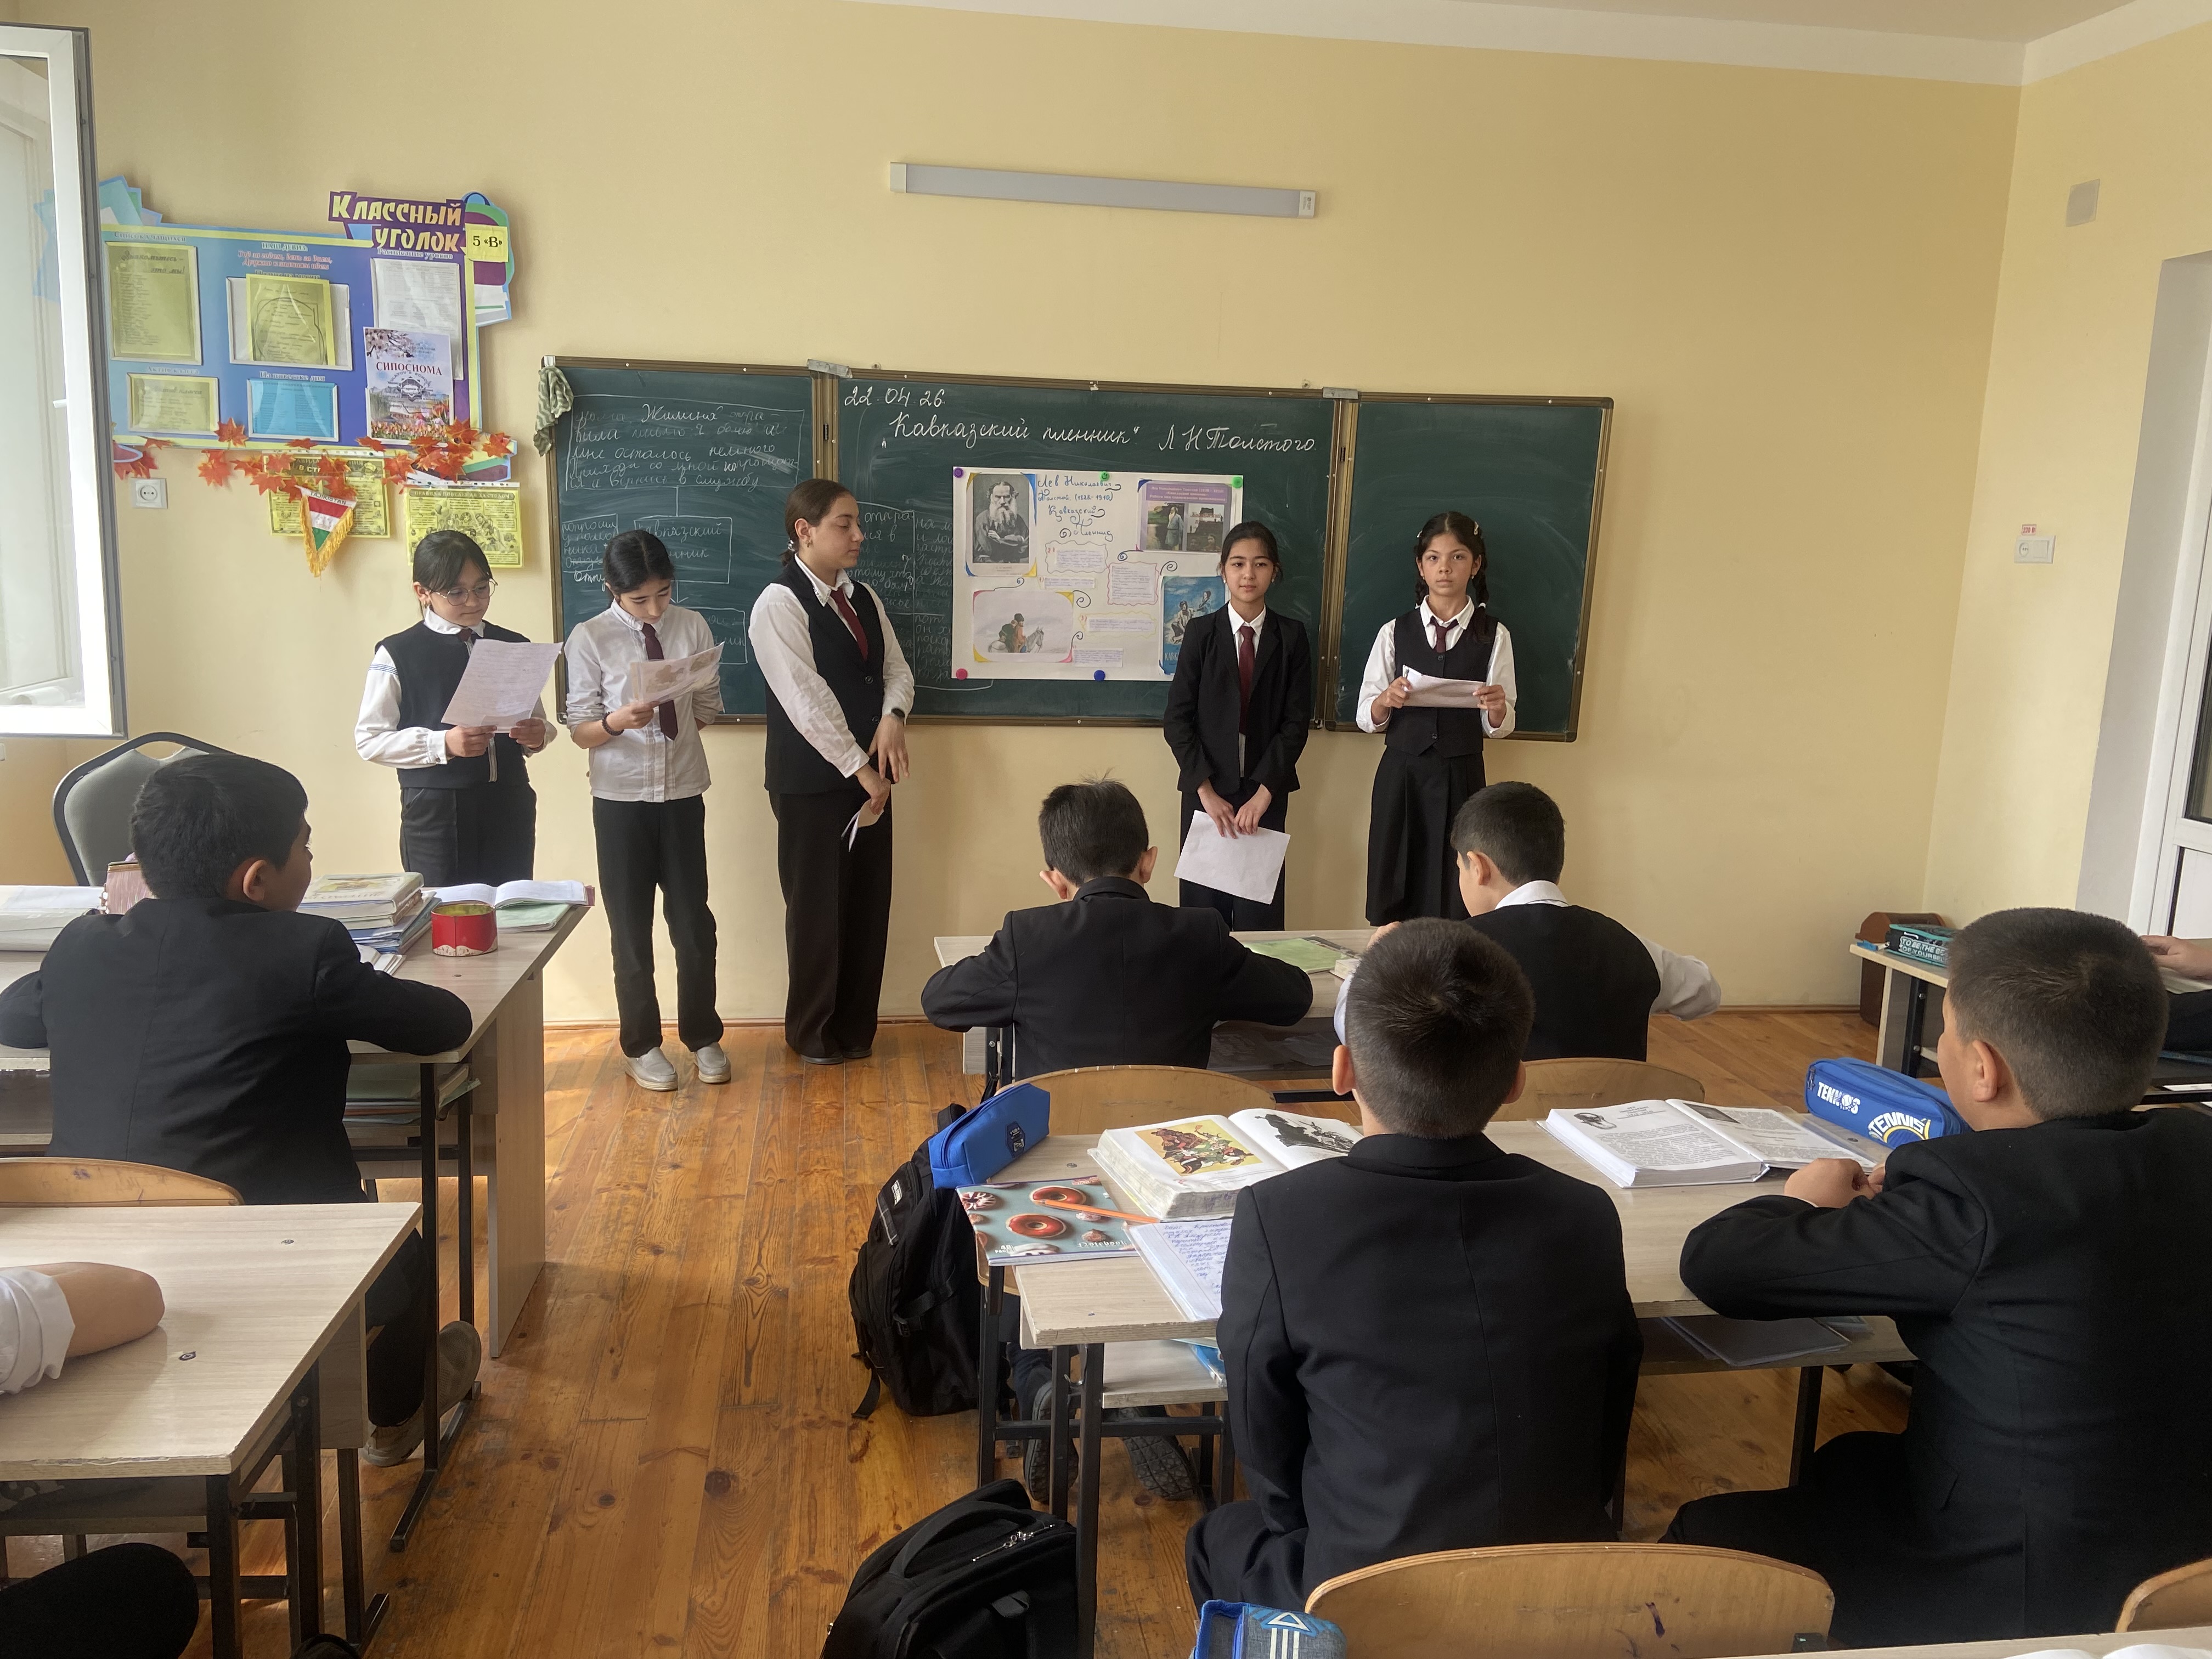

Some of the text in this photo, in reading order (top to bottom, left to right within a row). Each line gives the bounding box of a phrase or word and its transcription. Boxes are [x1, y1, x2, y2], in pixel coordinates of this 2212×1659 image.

[375, 228, 460, 252] УГОЛОК
[472, 235, 503, 248] 5 «В»
[376, 362, 442, 376] СИПОСНОМА
[1038, 474, 1111, 488] Лев Николаевич
[311, 491, 346, 505] TAJIKISTAN
[1048, 504, 1097, 522] Кавказский
[1902, 938, 1912, 946] TO
[1922, 943, 1936, 953] THE
[1867, 1111, 1927, 1137] TENNIS
[1078, 1239, 1128, 1249] Notebook
